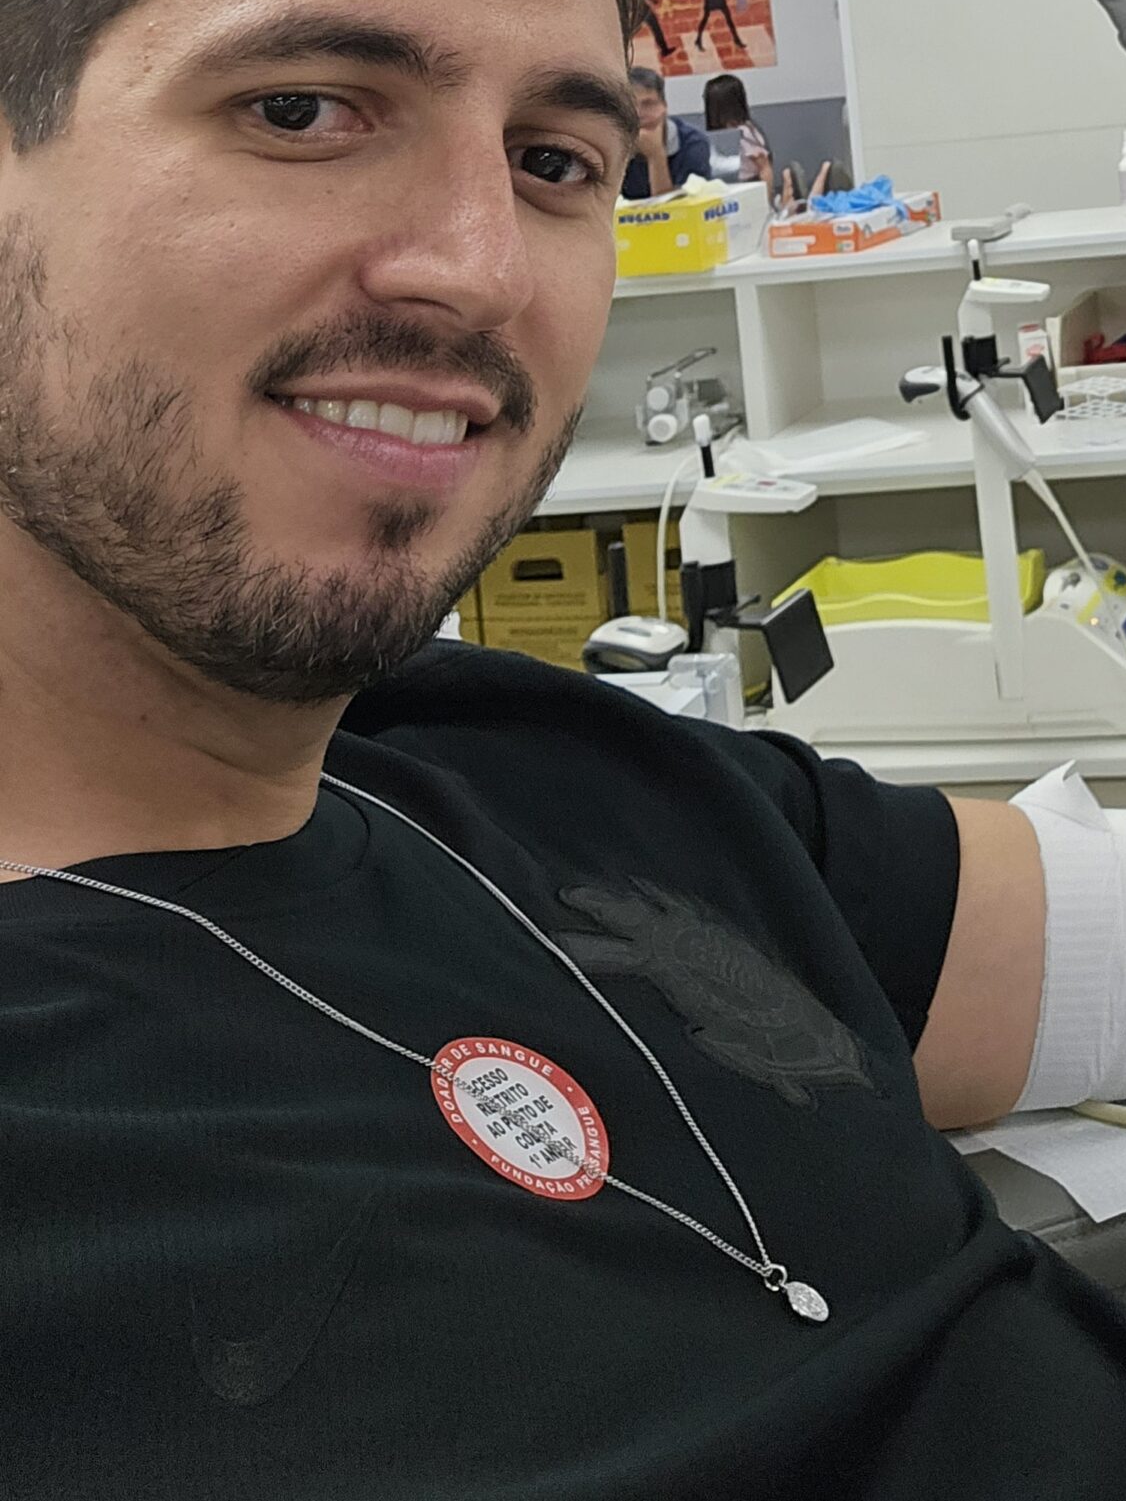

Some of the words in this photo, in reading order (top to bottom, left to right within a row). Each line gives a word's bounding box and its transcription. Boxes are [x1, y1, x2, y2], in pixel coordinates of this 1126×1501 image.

[436, 1057, 463, 1124] DOADR
[451, 1043, 473, 1061] DE
[475, 1041, 555, 1077] SANGUE
[467, 1067, 509, 1097] CESSO
[486, 1120, 505, 1140] AO
[500, 1102, 537, 1132] POTO
[536, 1094, 555, 1112] DE
[490, 1155, 575, 1195] FUNDAÇÃO
